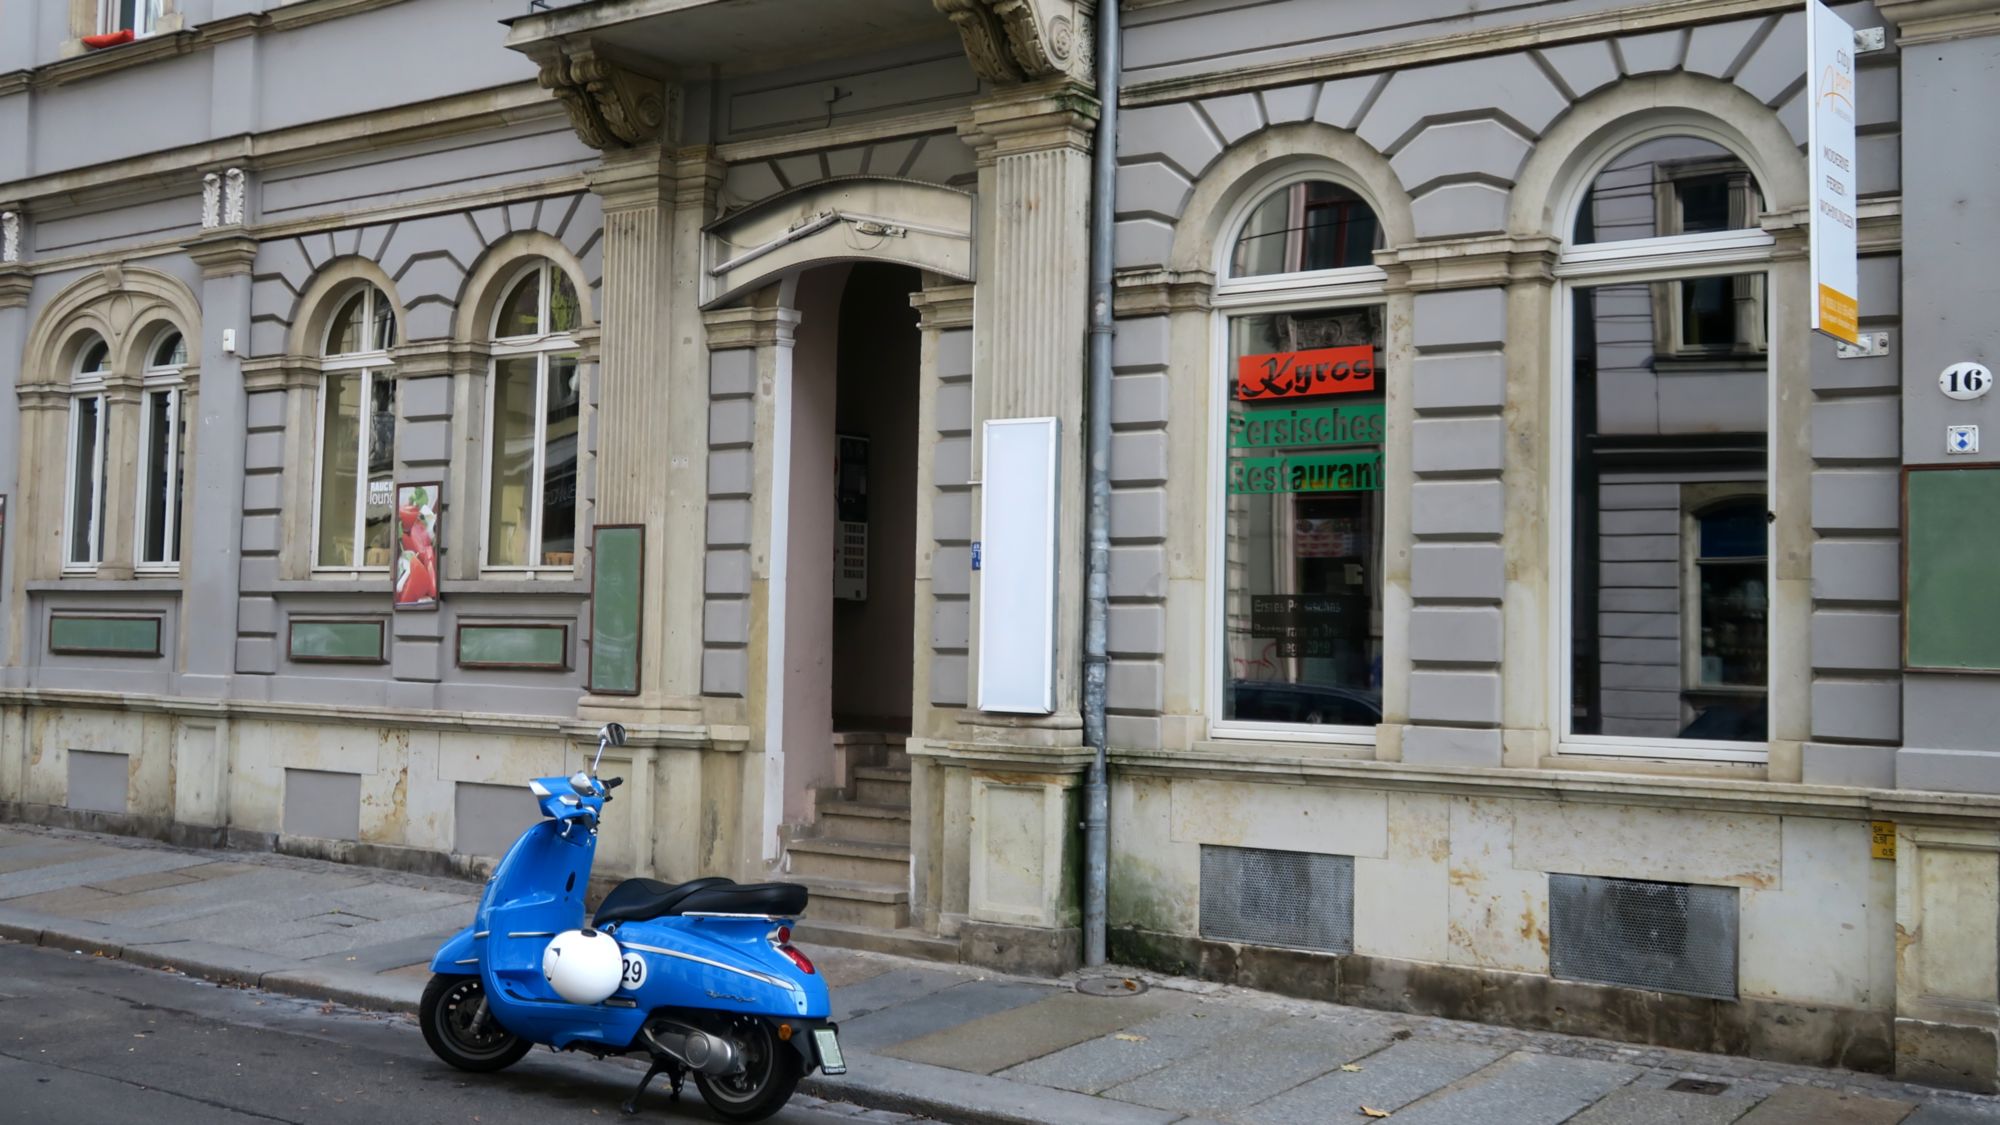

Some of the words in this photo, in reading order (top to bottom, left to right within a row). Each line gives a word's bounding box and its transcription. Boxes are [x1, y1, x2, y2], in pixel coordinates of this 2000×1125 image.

[1824, 146, 1849, 173] MODERNE
[1241, 355, 1371, 396] Kyros
[1947, 369, 1983, 392] 16
[1230, 408, 1384, 444] Persisches
[1230, 454, 1384, 491] Restaurant
[623, 959, 642, 983] 29
